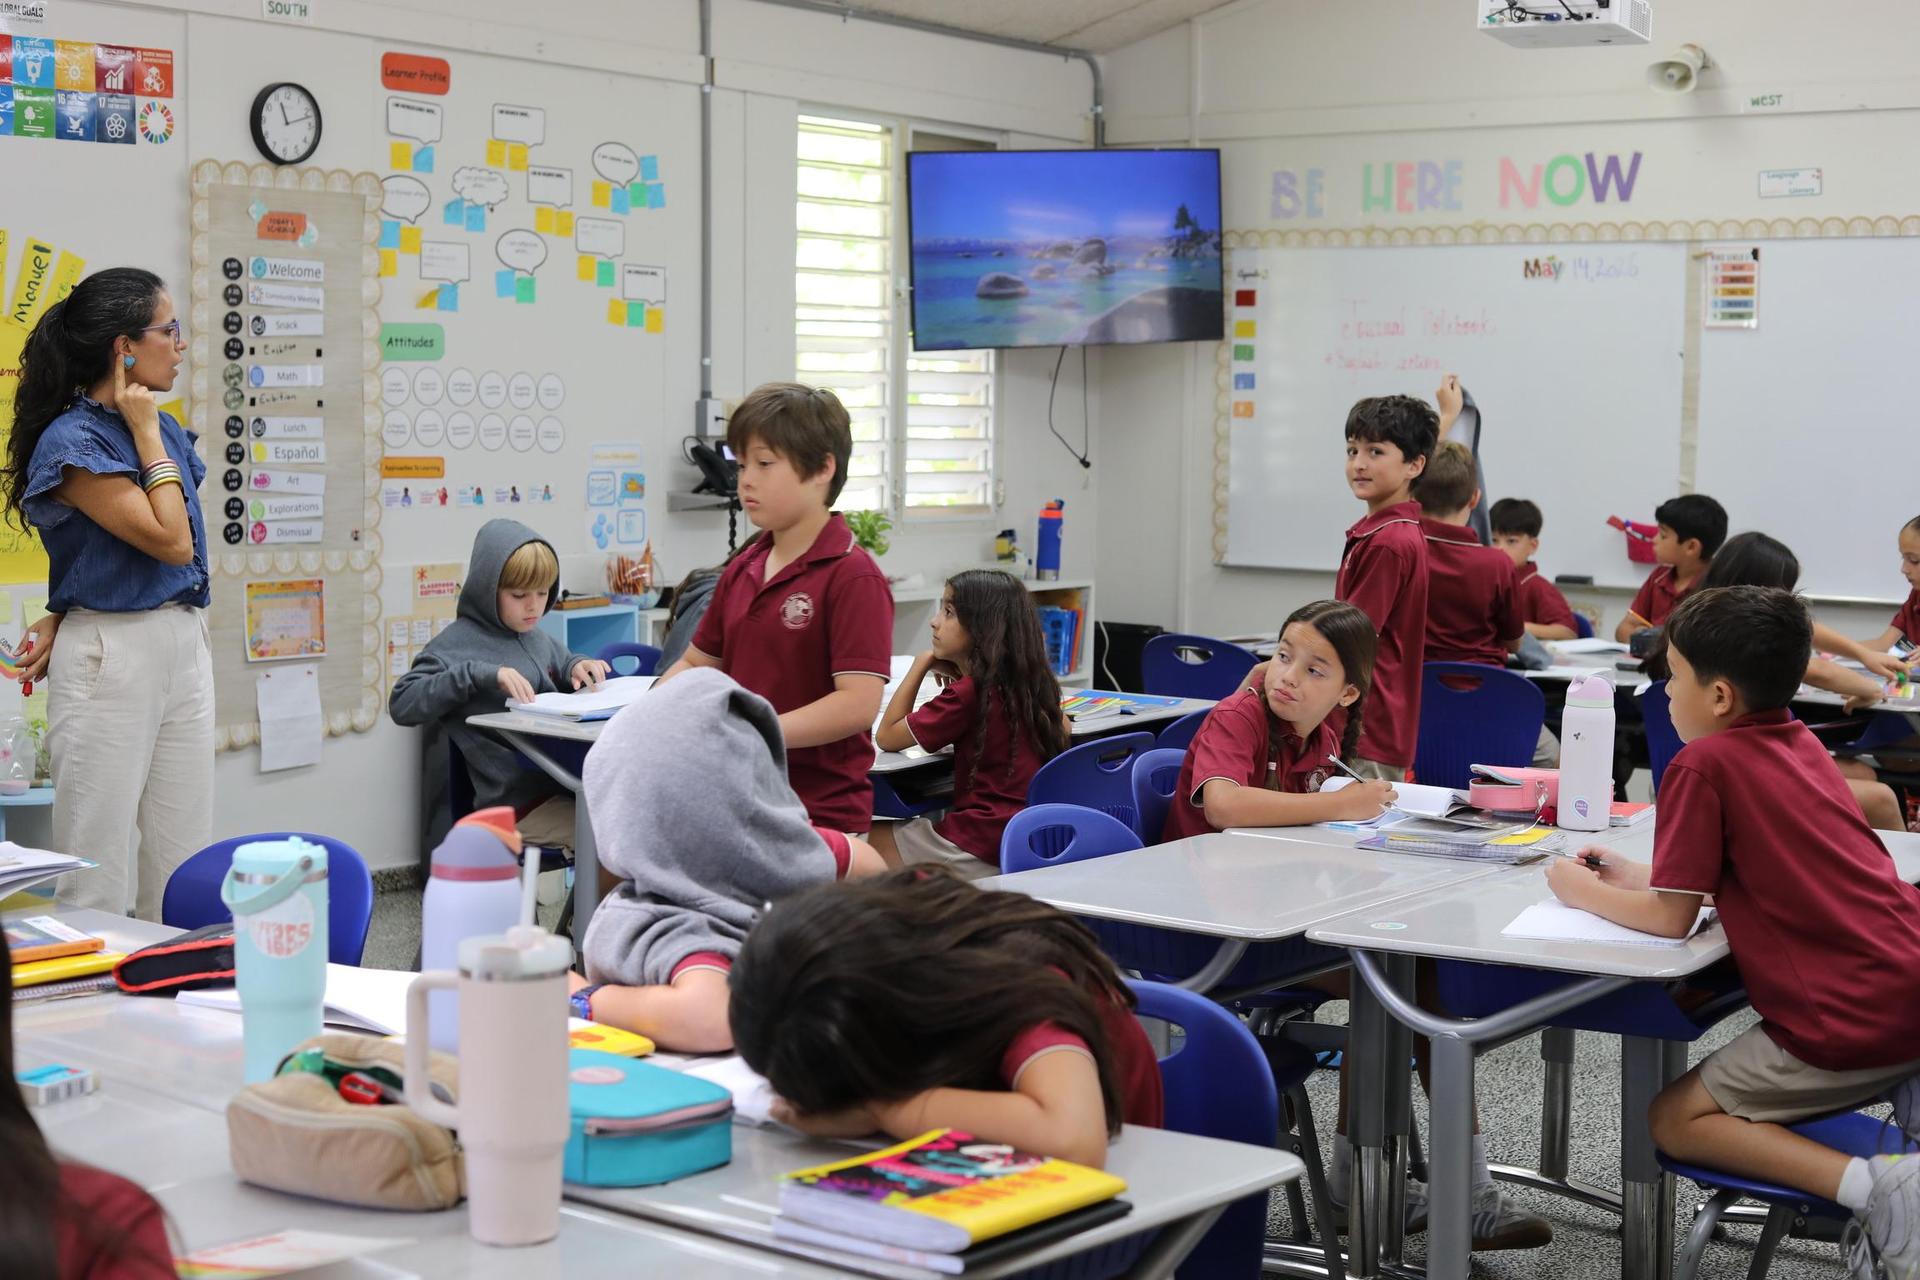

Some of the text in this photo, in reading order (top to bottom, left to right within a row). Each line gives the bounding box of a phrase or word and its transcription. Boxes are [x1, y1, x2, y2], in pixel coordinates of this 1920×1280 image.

[22, 5, 44, 18] GOALS
[268, 0, 307, 16] SOUTH
[384, 67, 447, 83] Learner Profile
[98, 97, 106, 109] 17
[1751, 94, 1783, 106] WEST
[1271, 152, 1642, 219] BE HERE NOW
[269, 263, 321, 279] Welcome
[1523, 258, 1563, 282] May
[14, 244, 52, 323] Manuel
[276, 321, 297, 330] Snack
[386, 336, 434, 348] Attitudes
[277, 371, 298, 380] Math
[283, 423, 307, 432] Lunch
[274, 446, 319, 462] Español
[286, 475, 299, 485] Art
[269, 503, 319, 516] Explorations
[276, 526, 312, 537] Dismissal
